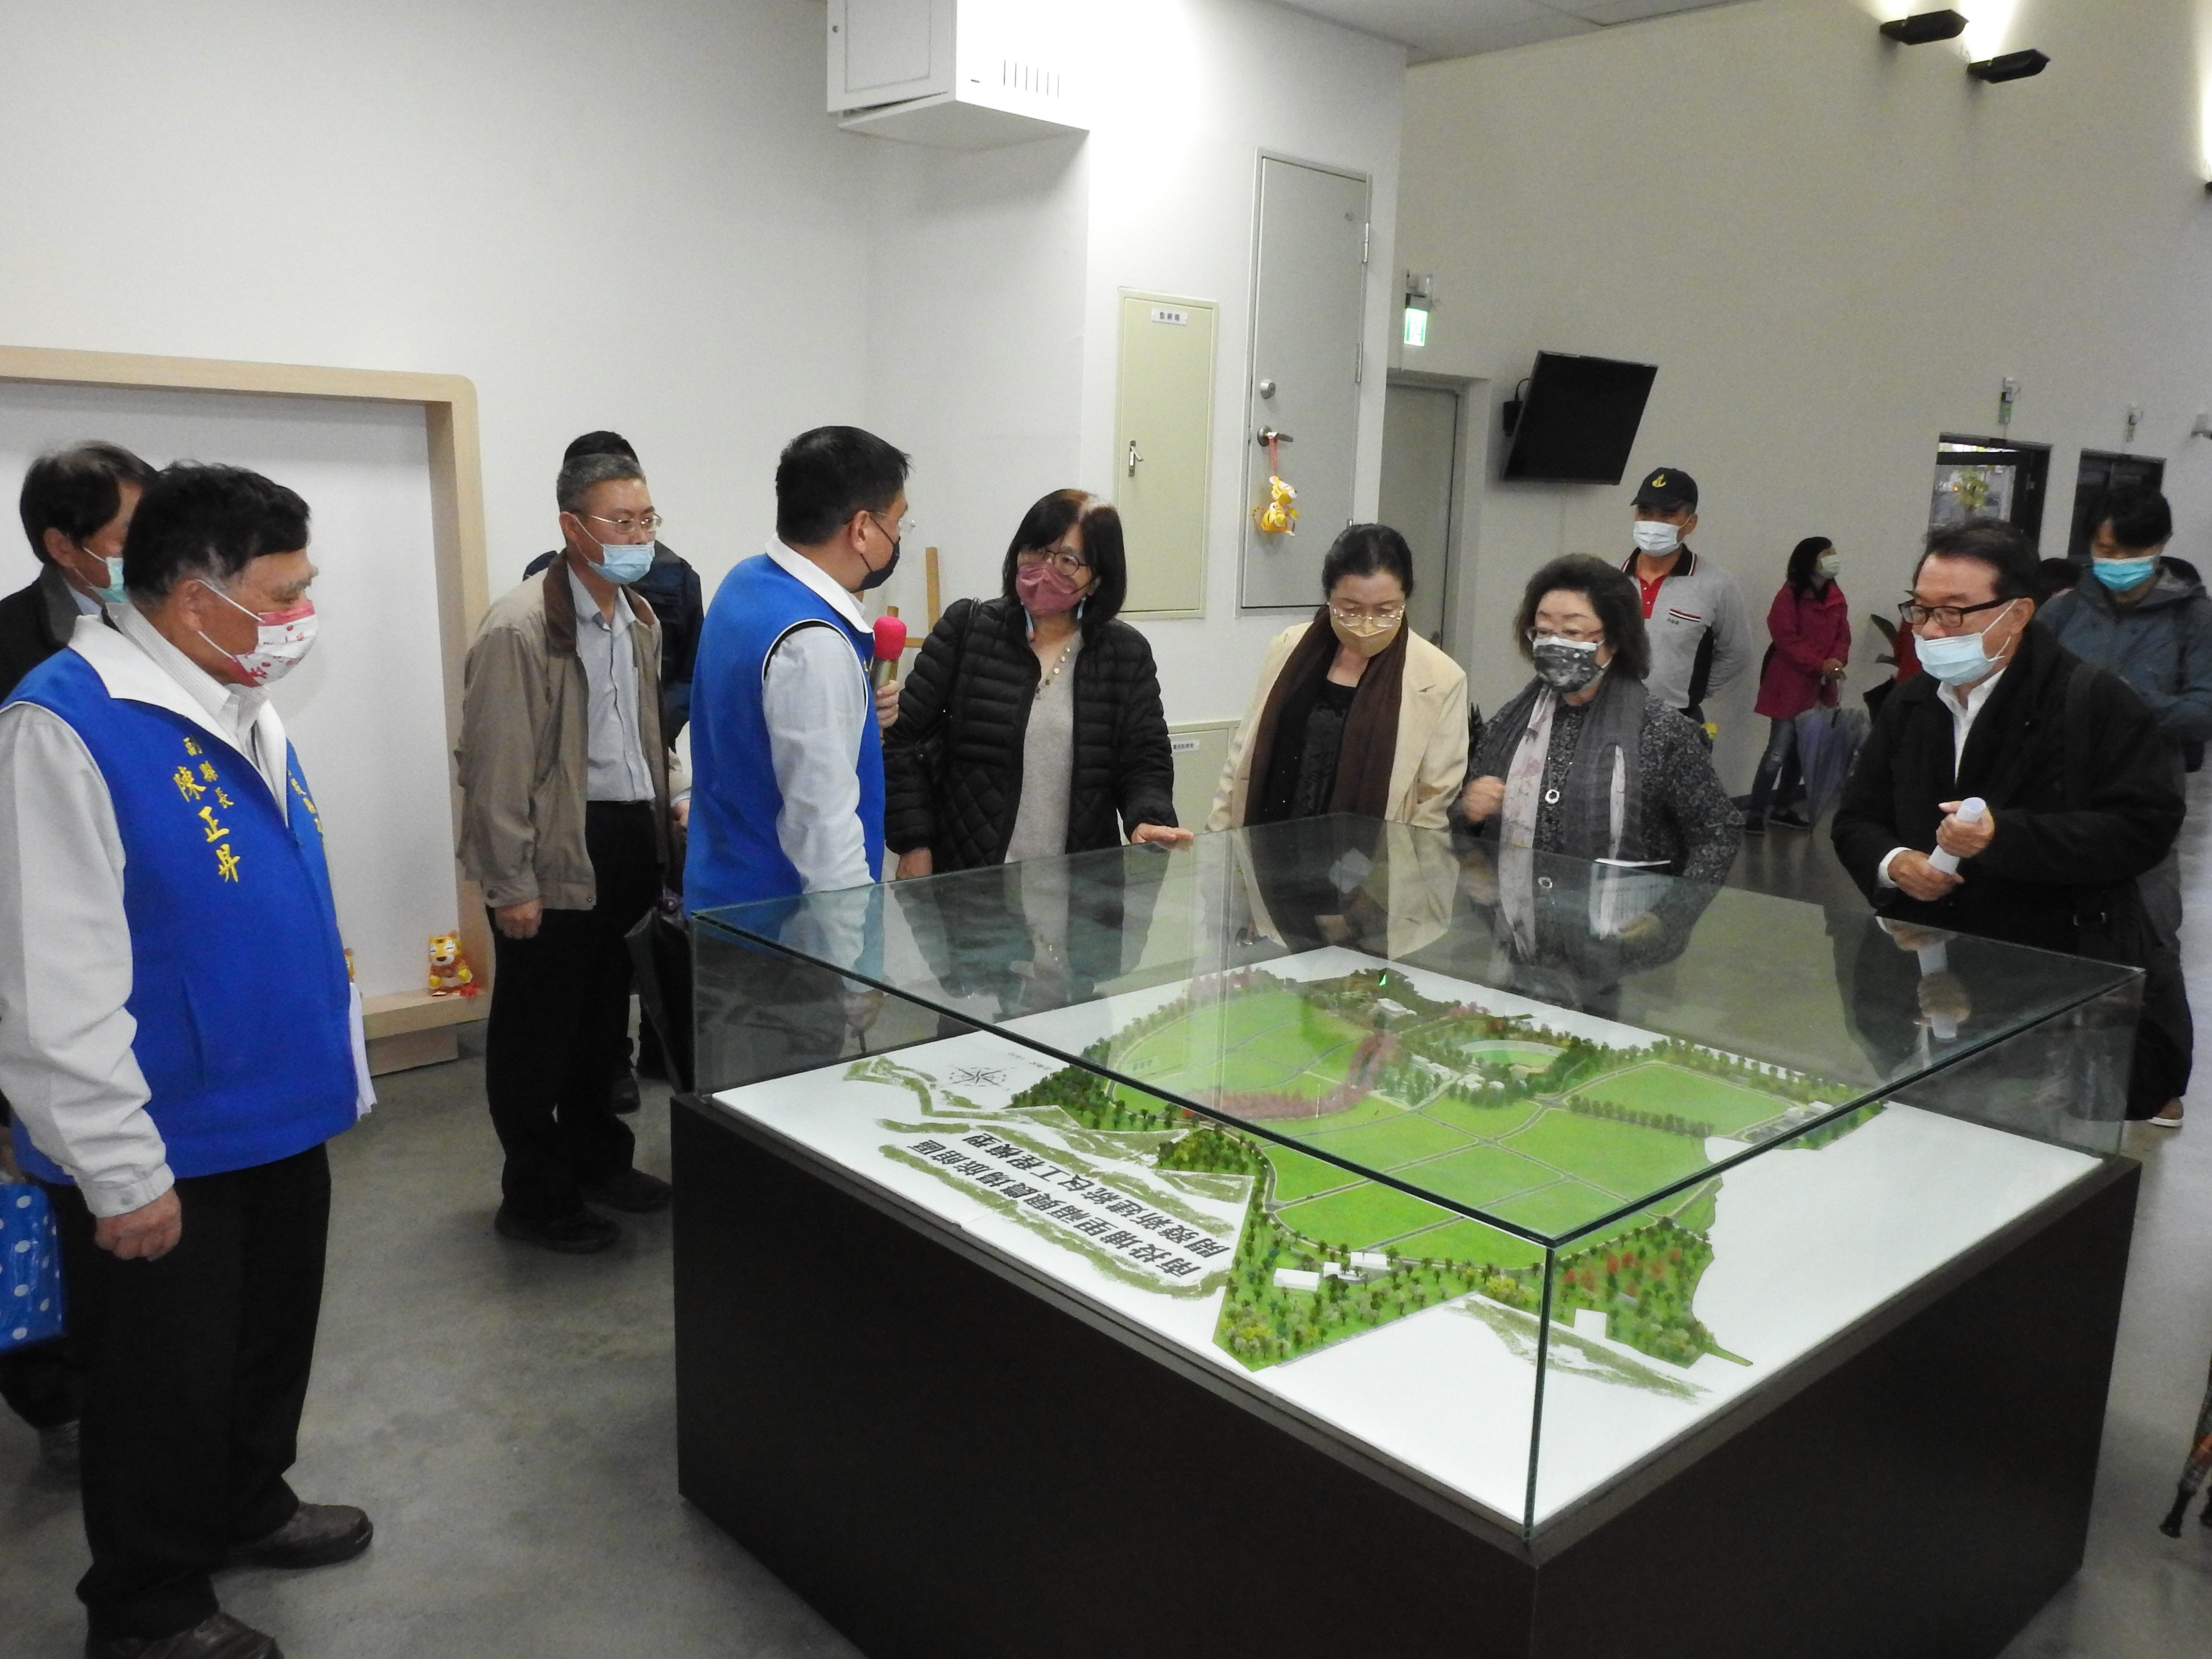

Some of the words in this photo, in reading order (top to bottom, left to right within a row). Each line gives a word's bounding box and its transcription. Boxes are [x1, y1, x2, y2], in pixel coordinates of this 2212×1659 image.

[173, 766, 240, 882] 陳正昇
[183, 734, 234, 809] 副縣長
[907, 1139, 1202, 1278] 南投埔里福興農場旅館區
[962, 1132, 1230, 1259] 開發新建統包工程模型
